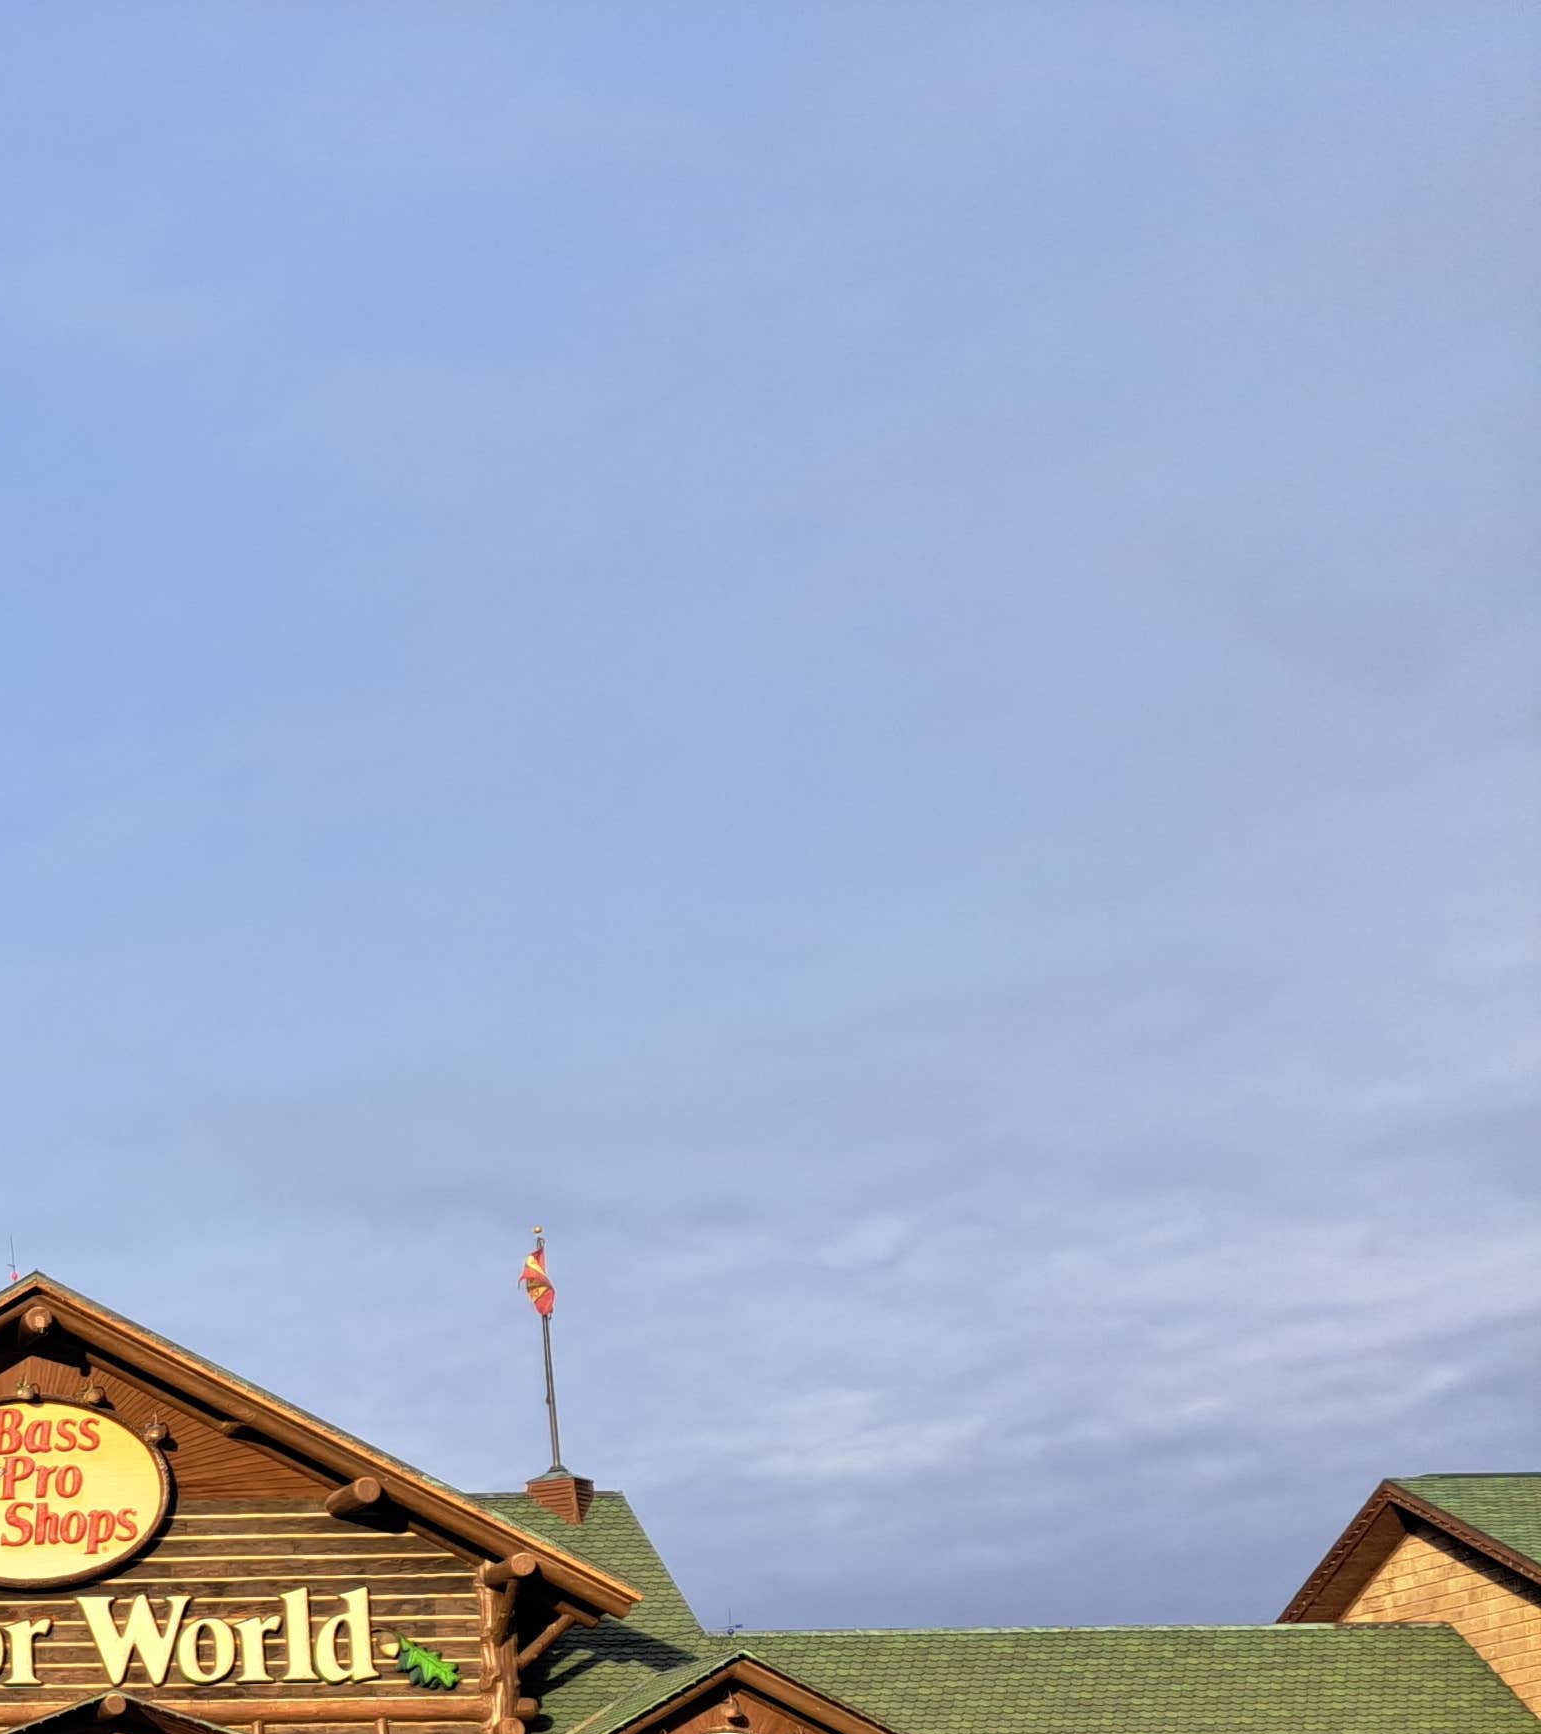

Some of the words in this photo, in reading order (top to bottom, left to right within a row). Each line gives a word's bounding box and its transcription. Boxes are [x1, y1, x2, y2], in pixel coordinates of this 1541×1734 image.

[0, 1456, 83, 1500] Pro
[1, 1502, 138, 1554] Shops
[76, 1586, 381, 1686] World
